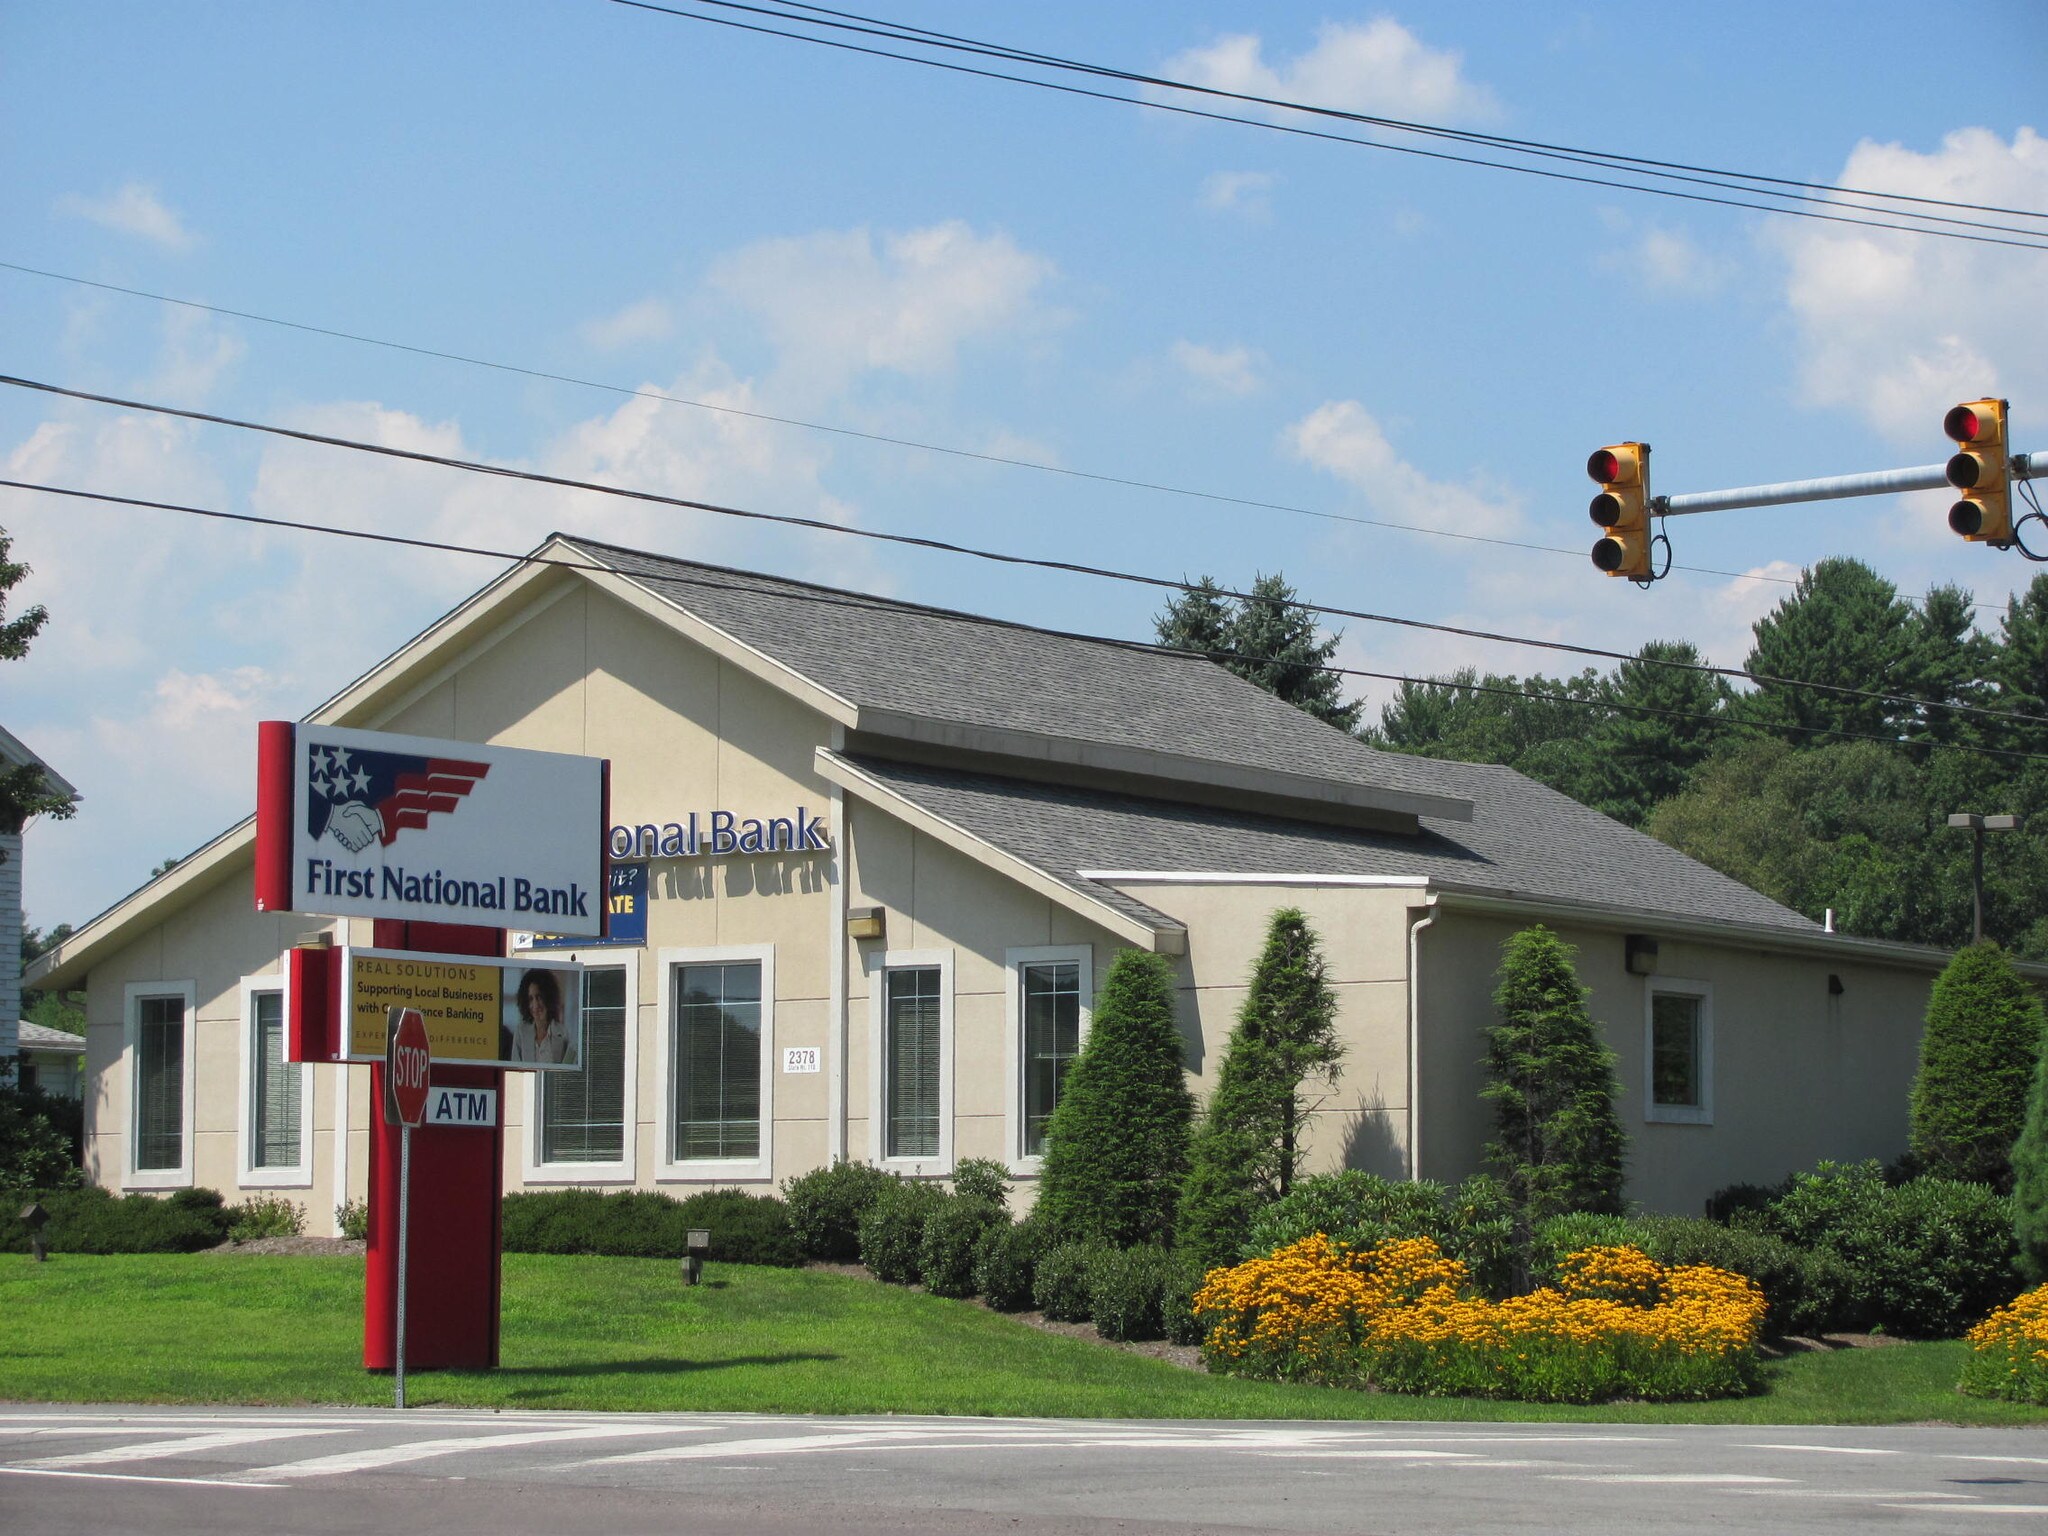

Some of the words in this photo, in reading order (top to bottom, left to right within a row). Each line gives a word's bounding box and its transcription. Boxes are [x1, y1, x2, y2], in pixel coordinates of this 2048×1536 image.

[609, 812, 701, 858] onal
[710, 806, 831, 854] Bank
[307, 858, 374, 899] First
[381, 865, 506, 911] National
[513, 878, 588, 918] Bank
[608, 894, 634, 914] ATE
[357, 960, 391, 975] REAL
[397, 964, 477, 981] SOLUTIONS
[357, 981, 412, 999] Supporting
[415, 985, 440, 998] Local
[442, 987, 494, 1002] Businesses
[357, 1002, 379, 1015] with
[446, 1007, 484, 1022] Banking
[429, 1034, 488, 1046] DIFFERENCE
[396, 1046, 428, 1089] STOP
[789, 1050, 816, 1065] 2378
[436, 1091, 488, 1121] ATM
